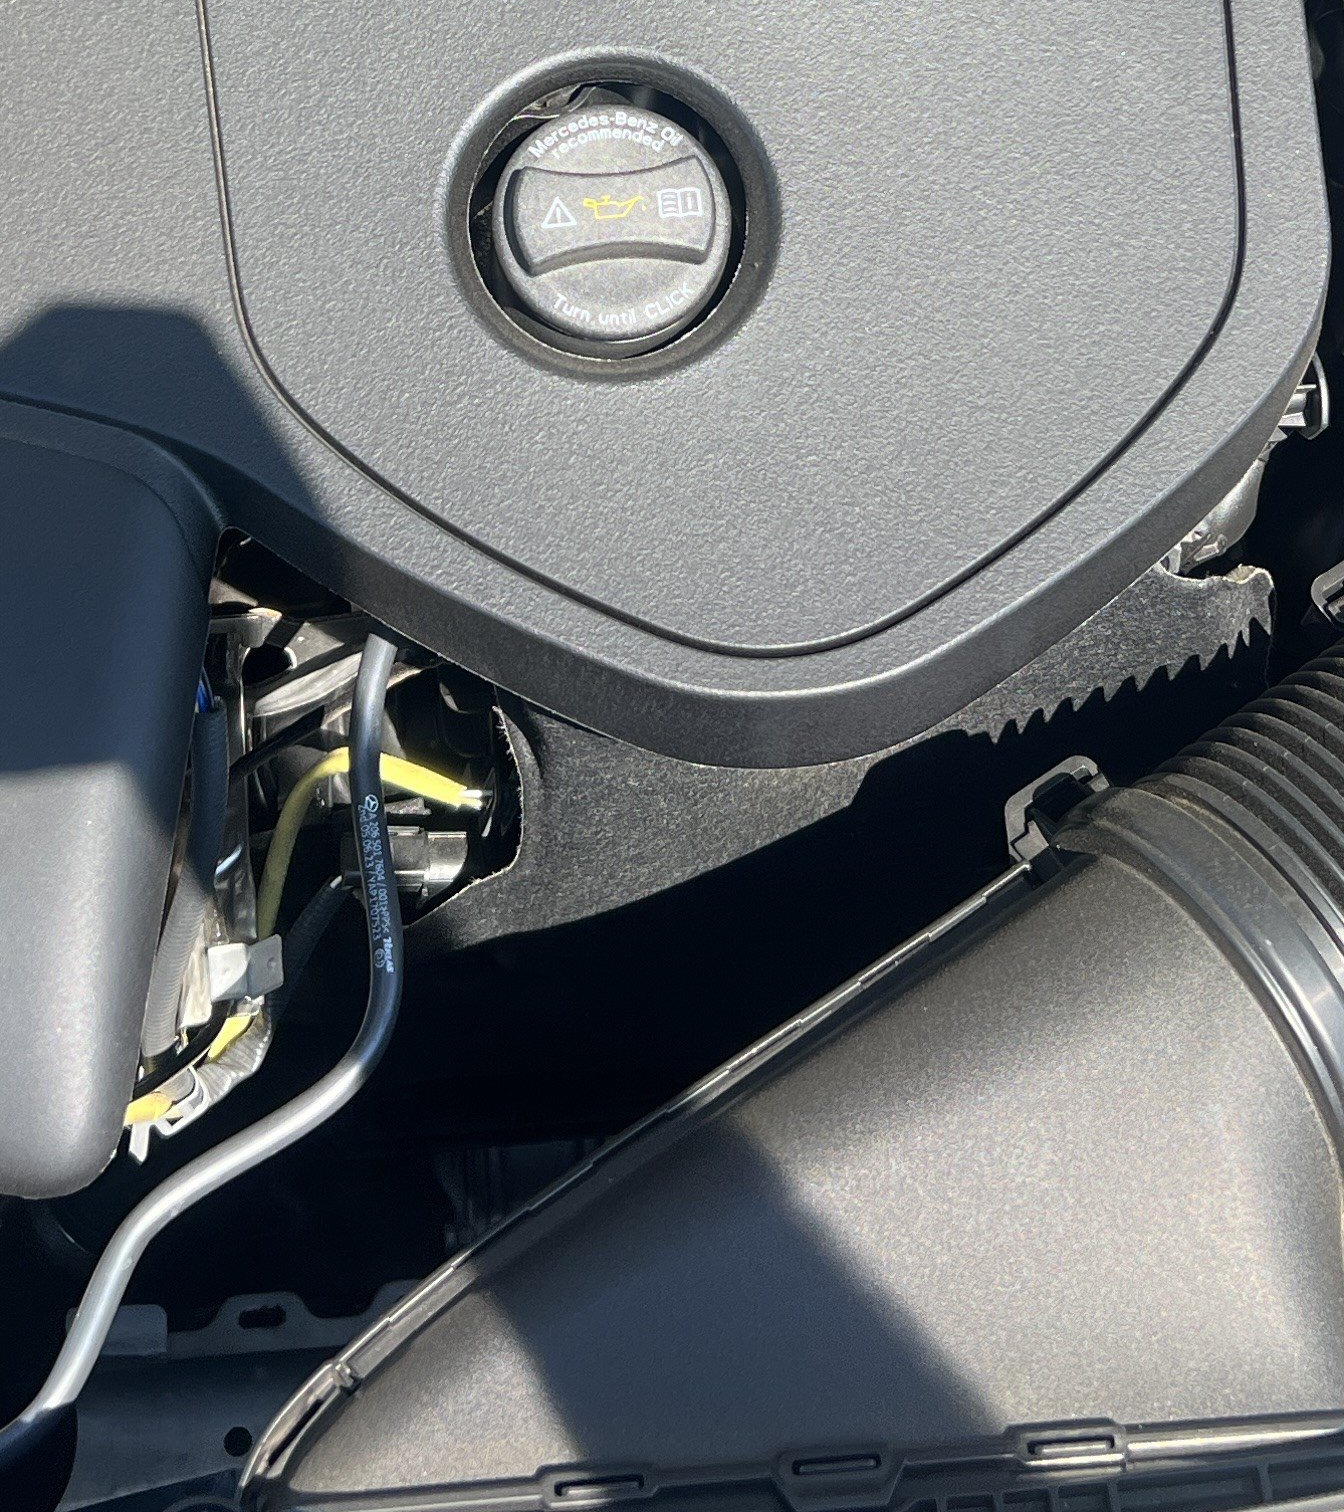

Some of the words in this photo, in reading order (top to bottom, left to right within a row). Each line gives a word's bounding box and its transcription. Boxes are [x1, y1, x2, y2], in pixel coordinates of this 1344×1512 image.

[527, 110, 659, 159] Mercedes-Benz
[660, 125, 685, 147] Oil
[550, 127, 666, 160] recommended
[553, 292, 592, 324] Turn
[598, 307, 638, 326] until
[643, 281, 696, 320] CLICK
